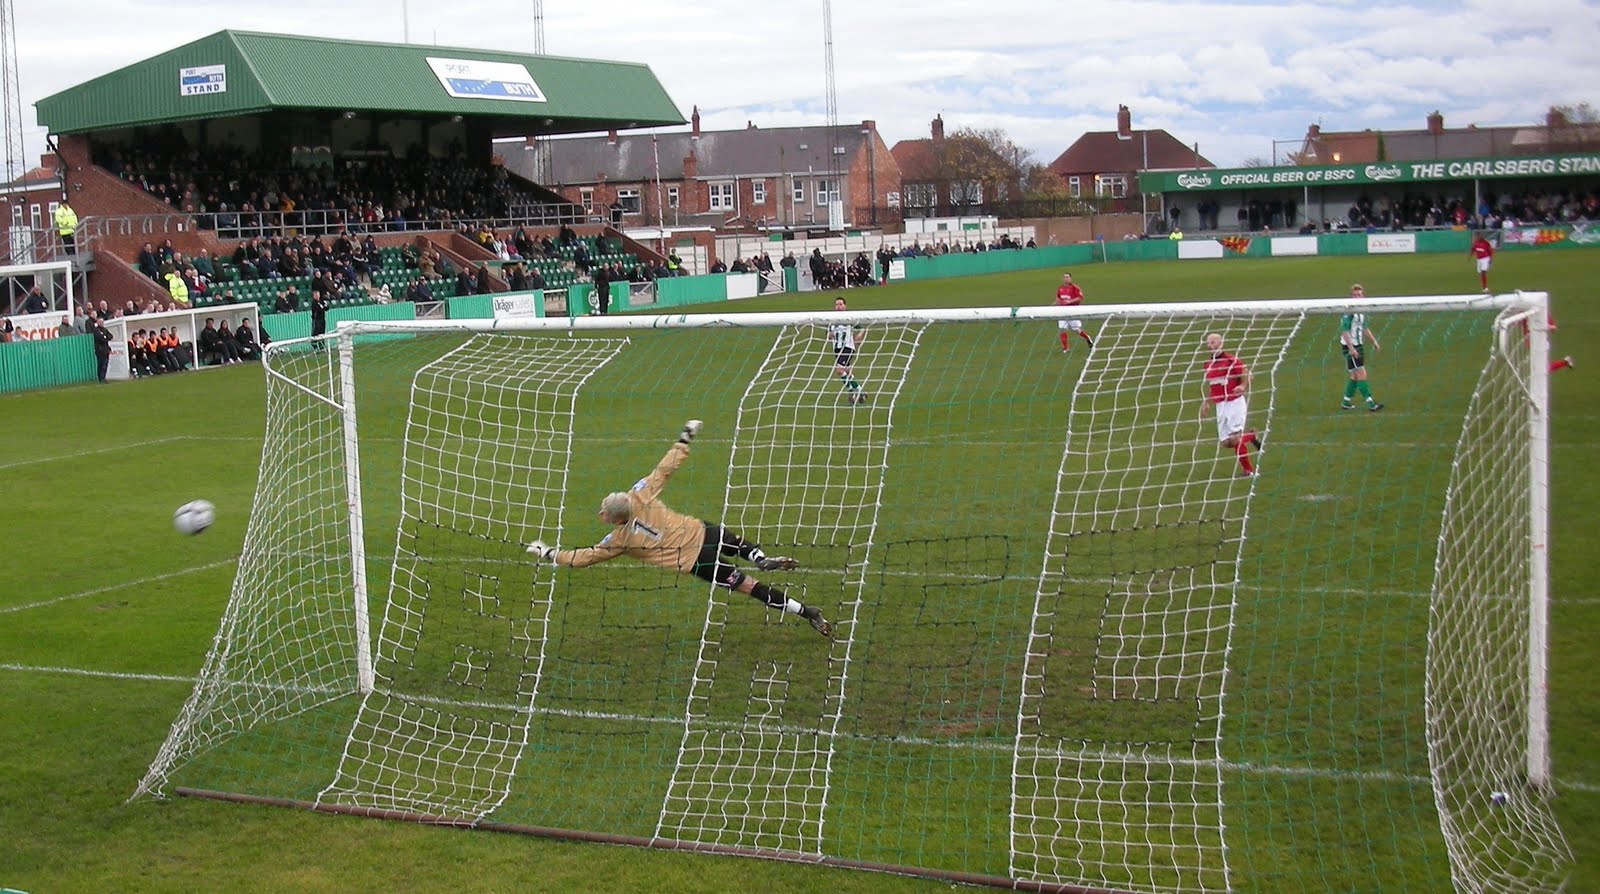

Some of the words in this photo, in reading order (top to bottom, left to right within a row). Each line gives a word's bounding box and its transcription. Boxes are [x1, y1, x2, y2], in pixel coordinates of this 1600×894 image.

[187, 84, 220, 94] STAND
[504, 84, 536, 96] BLYTH
[1177, 173, 1212, 188] Carlsberg
[1220, 173, 1270, 185] OFFICIAL
[1273, 171, 1304, 183] BEER
[1306, 170, 1323, 181] OF
[1324, 169, 1356, 180] BSFC
[1365, 165, 1402, 181] Carlsberg
[1411, 163, 1446, 178] THE
[1448, 159, 1556, 177] CARLSBERG
[632, 517, 664, 541] 1
